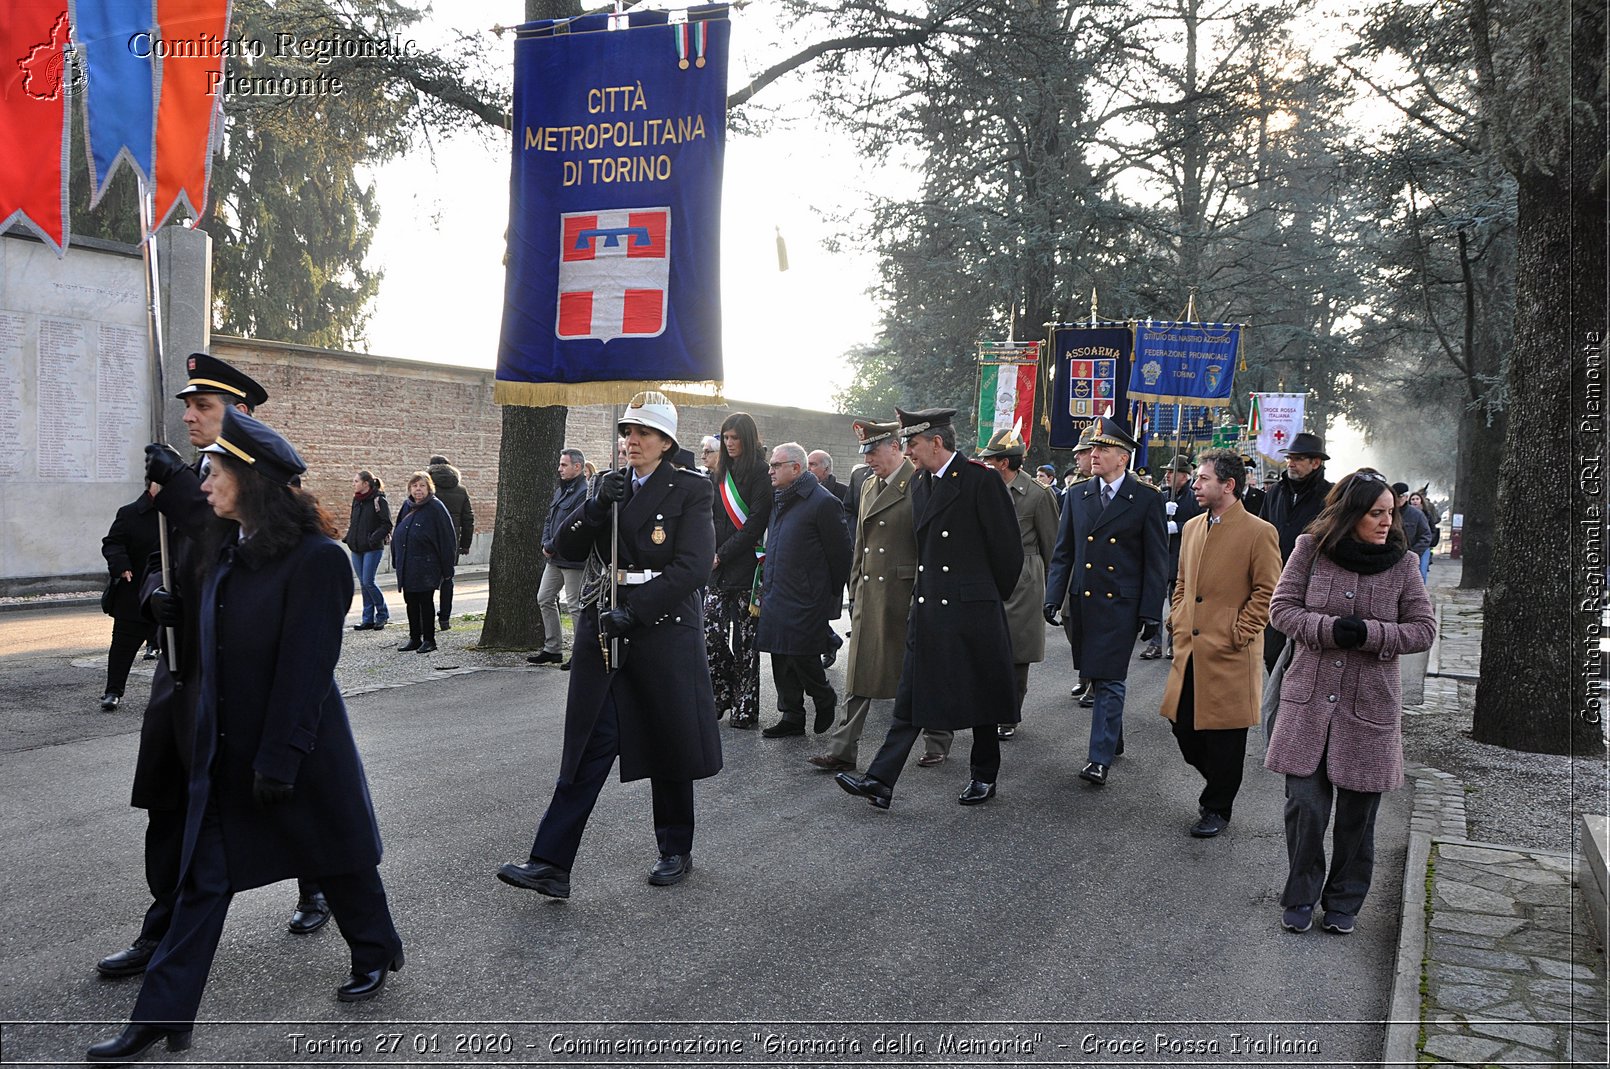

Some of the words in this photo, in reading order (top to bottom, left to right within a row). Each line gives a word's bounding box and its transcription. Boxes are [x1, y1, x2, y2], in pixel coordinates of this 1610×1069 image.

[588, 80, 647, 114] CITTÀ
[524, 114, 706, 152] METROPOLITANA
[563, 161, 582, 187] DI
[588, 155, 672, 185] TORINO
[1065, 346, 1120, 360] ASSOARMA
[1144, 348, 1187, 358] FEDERAZIONE
[1188, 351, 1229, 361] PROVINCIALE
[1172, 370, 1196, 379] TORINO
